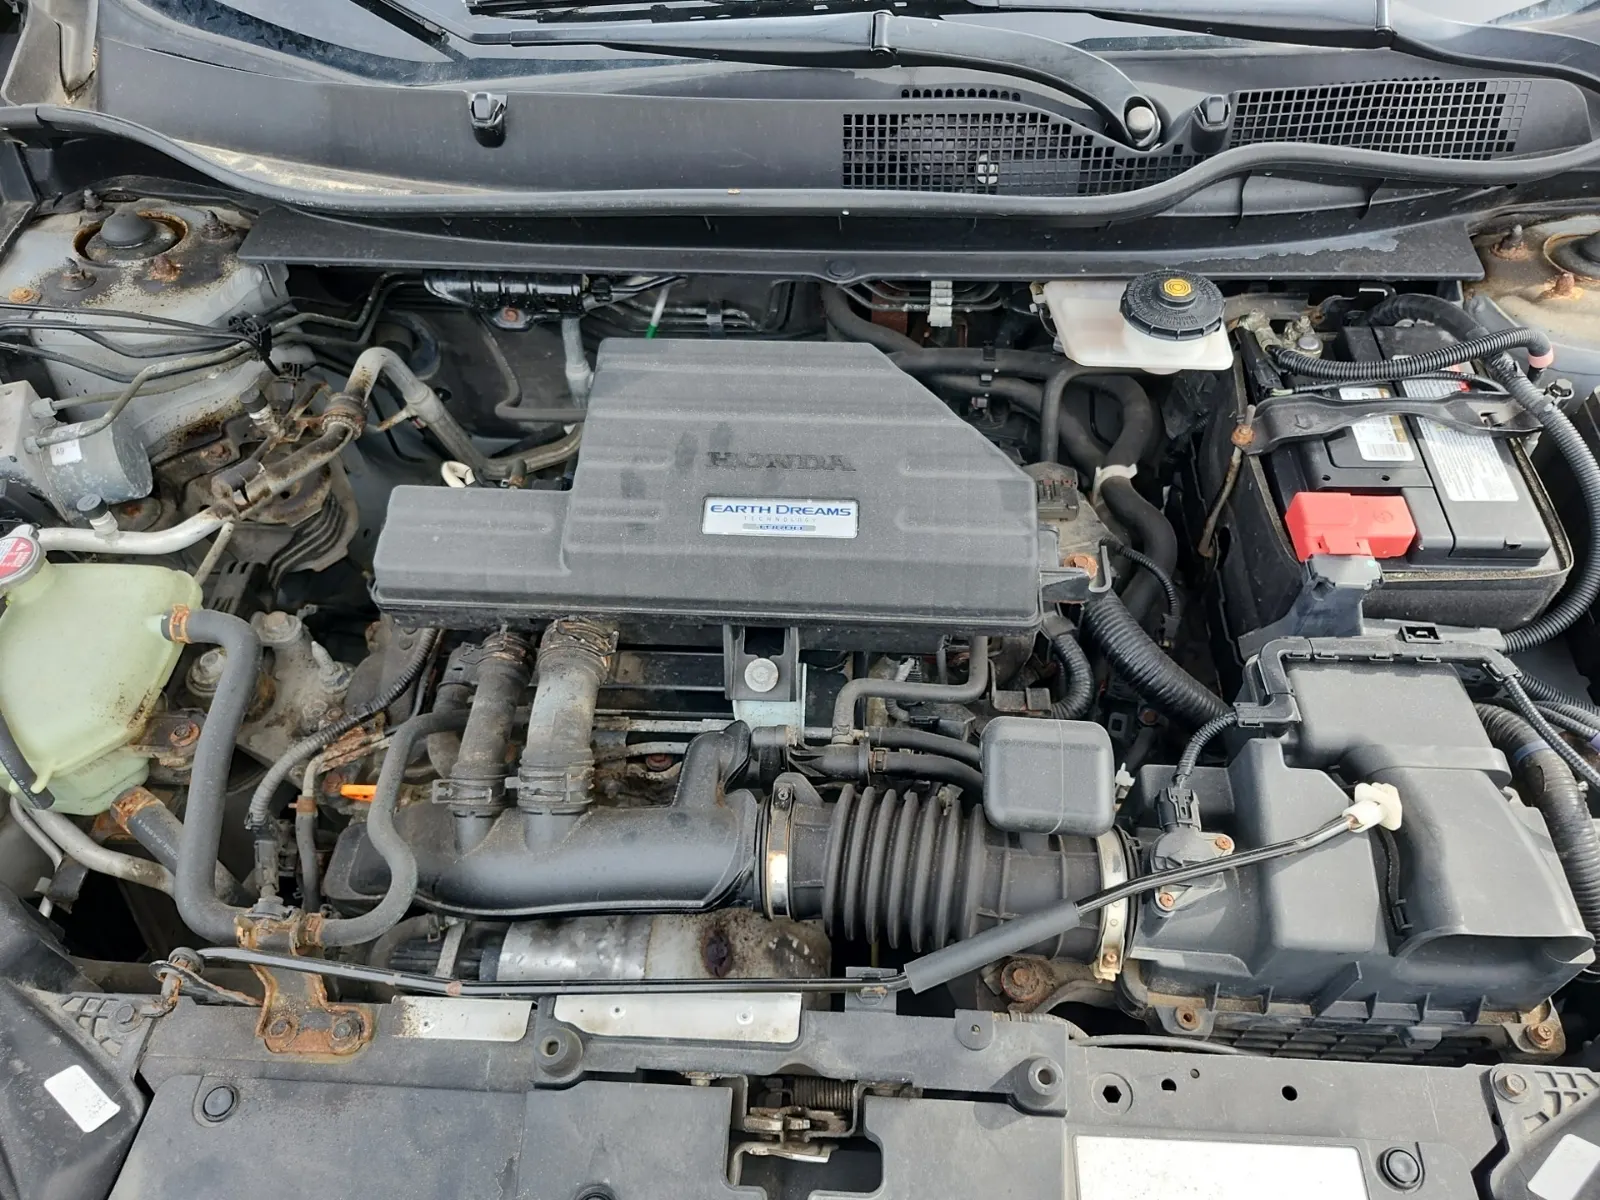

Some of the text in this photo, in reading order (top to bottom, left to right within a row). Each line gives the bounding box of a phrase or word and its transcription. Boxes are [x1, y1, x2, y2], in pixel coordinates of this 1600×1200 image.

[705, 451, 857, 472] HONDA
[710, 504, 851, 517] EARTH DREAMS
